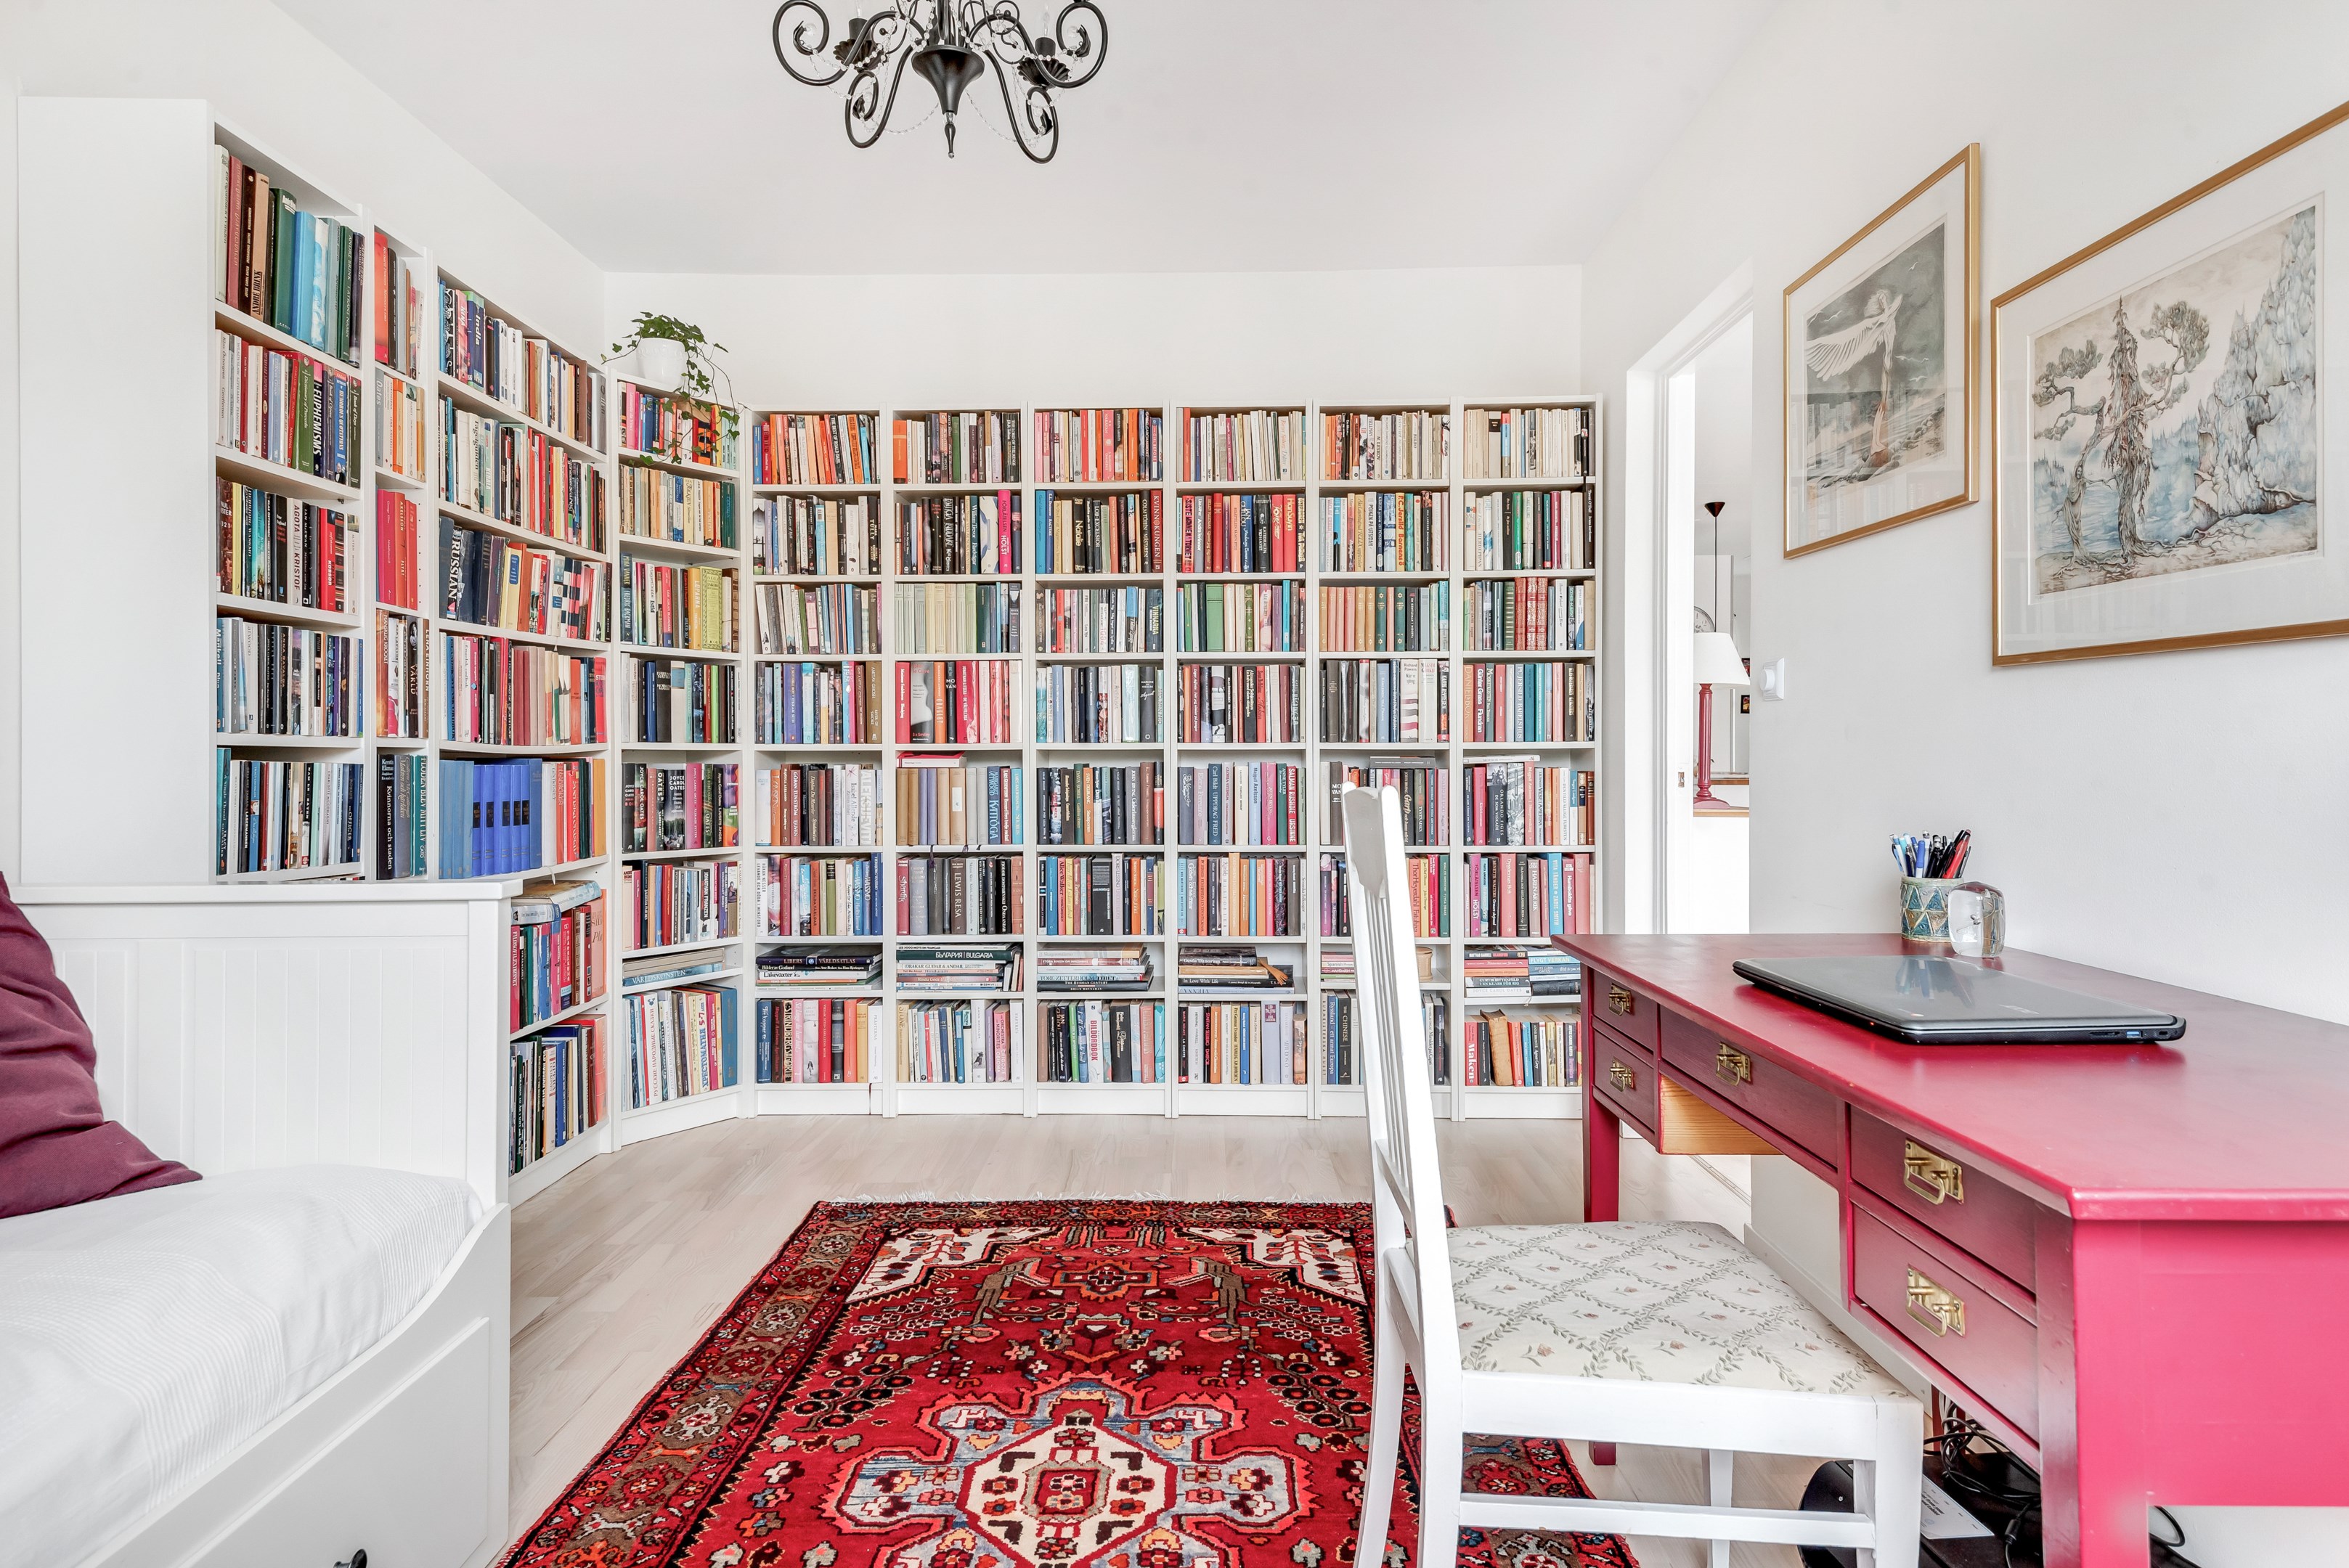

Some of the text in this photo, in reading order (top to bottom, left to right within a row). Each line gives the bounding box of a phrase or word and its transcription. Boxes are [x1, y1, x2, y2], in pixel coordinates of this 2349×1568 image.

[252, 270, 262, 315] ANDRÉ BRINK
[313, 390, 322, 455] EUPHEMISMS
[448, 541, 460, 599] RUSSIAN
[989, 800, 1000, 839] KATTÖGA
[632, 968, 686, 984] VÄRLDSKONSTEN
[1468, 1043, 1477, 1079] Maken
